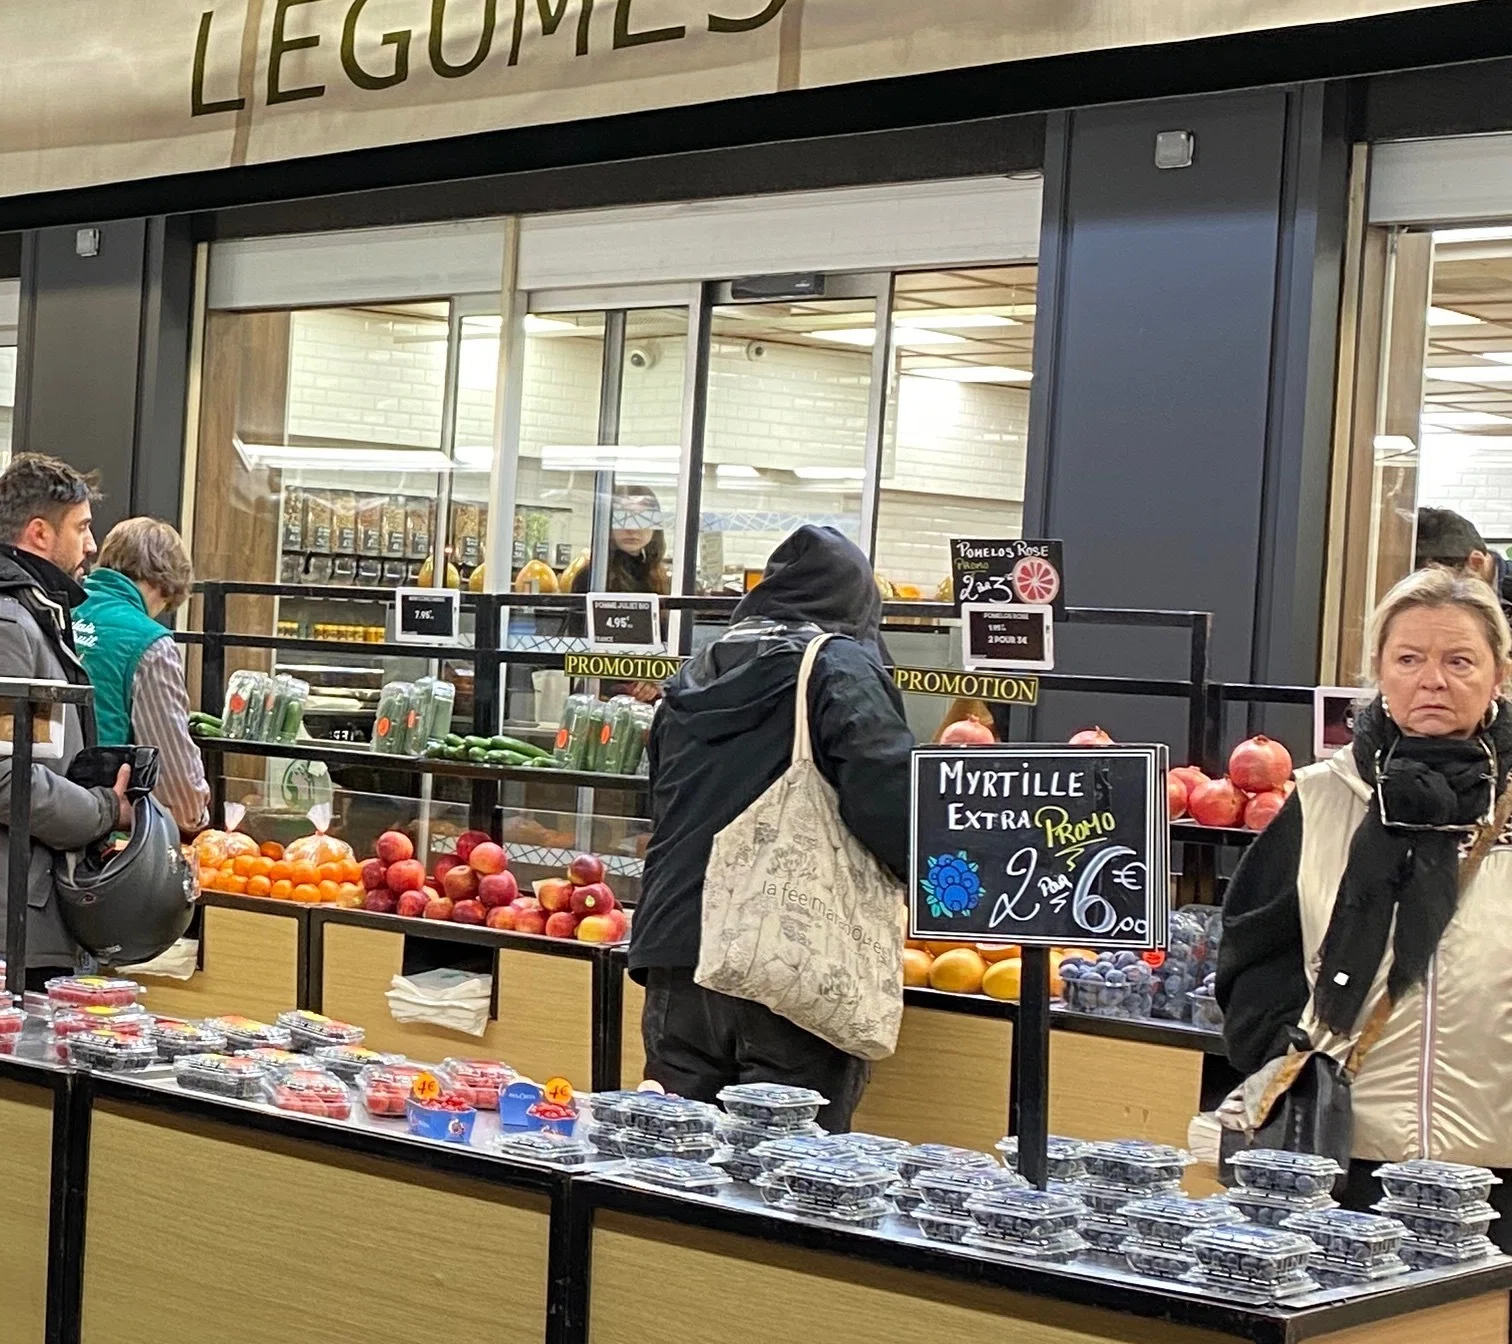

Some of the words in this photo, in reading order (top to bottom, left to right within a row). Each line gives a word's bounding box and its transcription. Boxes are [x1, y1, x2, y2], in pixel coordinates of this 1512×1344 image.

[1013, 540, 1049, 557] ROSE
[567, 655, 681, 678] PROMOTION
[896, 669, 1036, 701] PROMOTION
[948, 803, 1032, 831] EXTRA
[1034, 805, 1116, 848] PROMO
